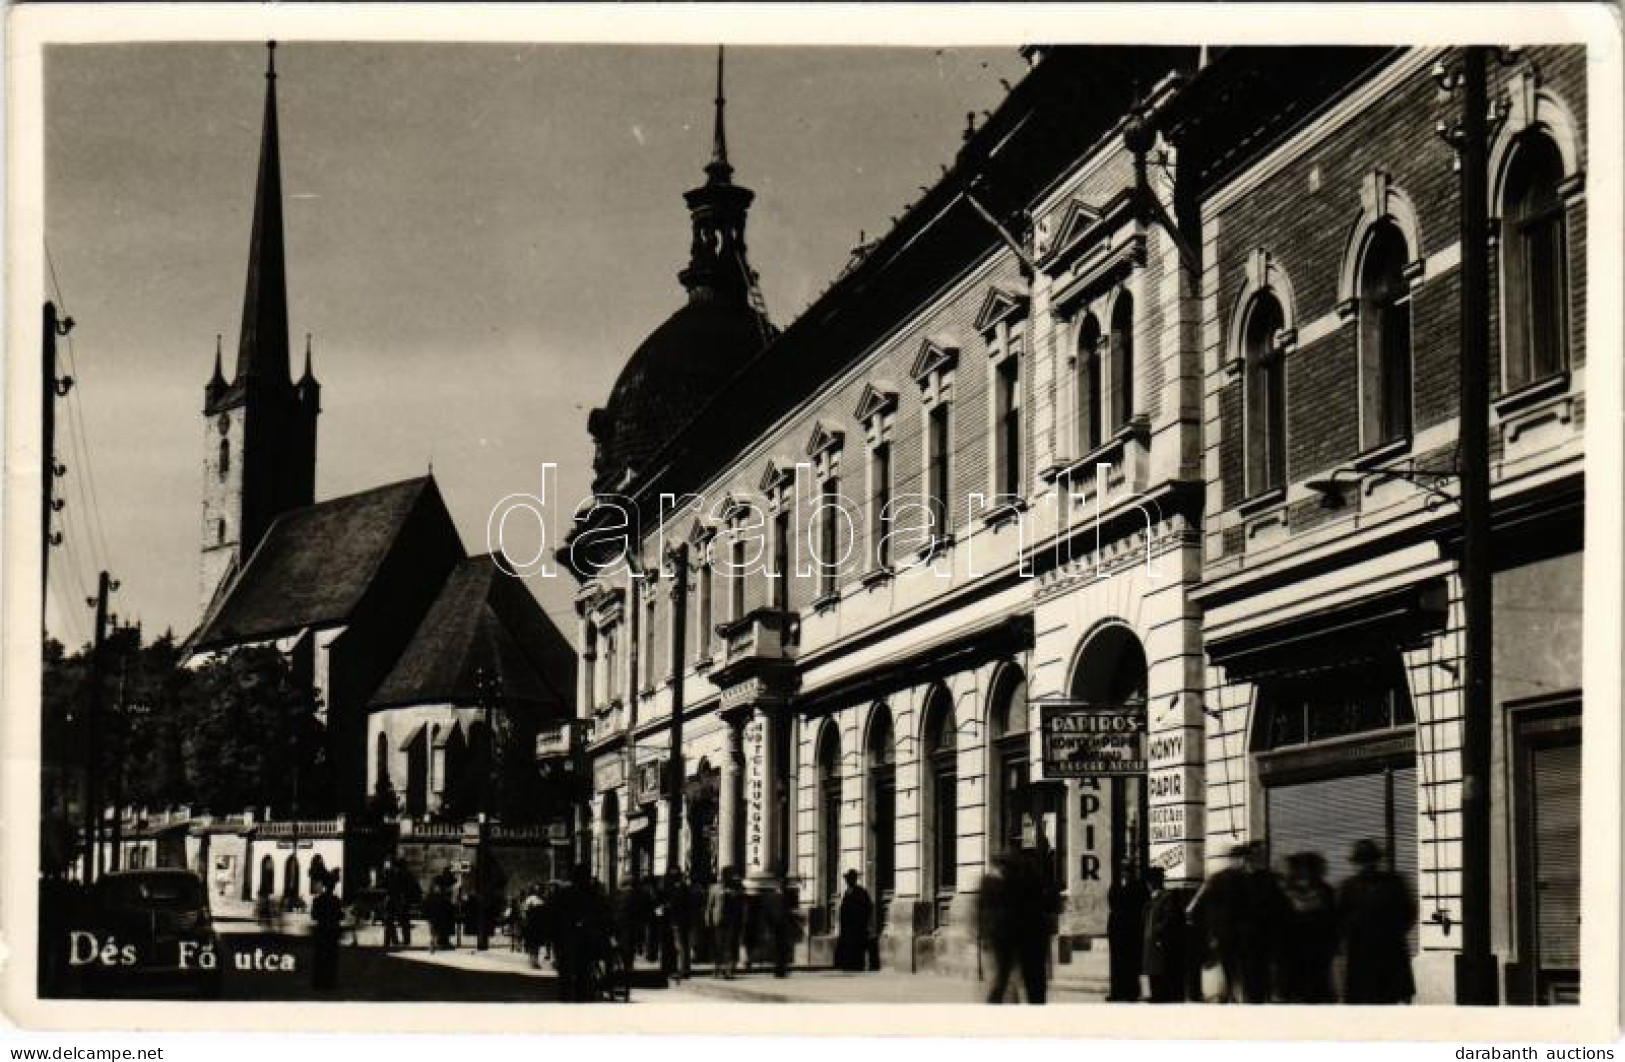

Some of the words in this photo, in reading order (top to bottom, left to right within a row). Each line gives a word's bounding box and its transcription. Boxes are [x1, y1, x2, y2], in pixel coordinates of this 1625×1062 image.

[753, 723, 763, 776] HOTEL
[751, 779, 763, 866] HUNGARIA
[1079, 777, 1100, 880] APIR
